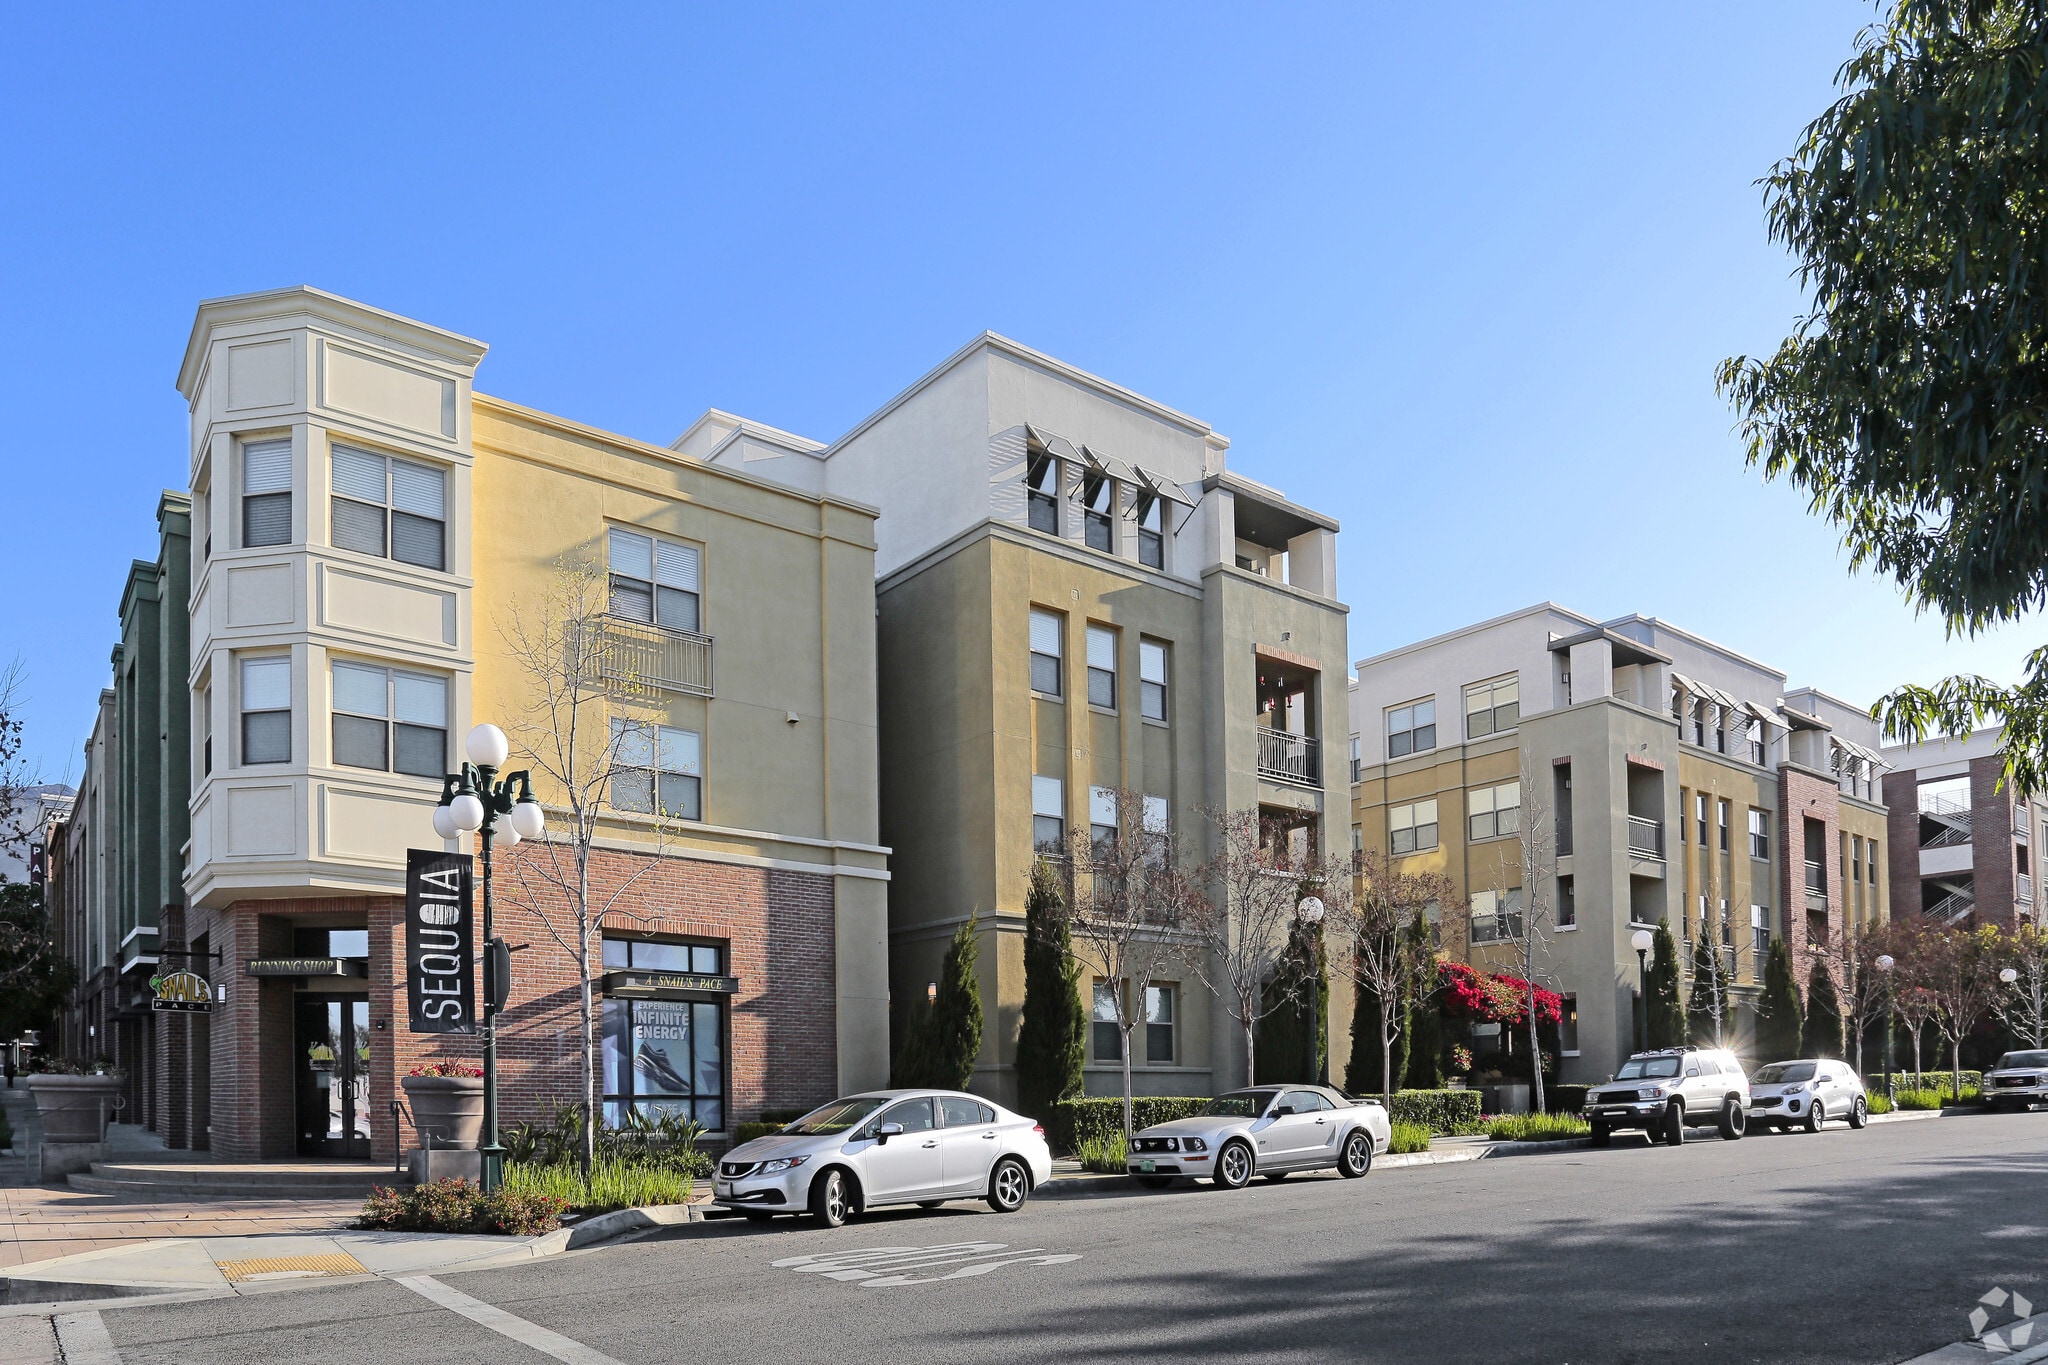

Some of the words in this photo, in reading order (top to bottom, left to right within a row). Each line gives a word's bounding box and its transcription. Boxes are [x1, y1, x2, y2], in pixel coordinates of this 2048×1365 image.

[419, 868, 462, 1020] SEQUOIA
[250, 960, 301, 973] RUNNING
[303, 960, 334, 973] SHOP
[645, 976, 653, 986] A
[657, 976, 694, 988] SNAIL'S
[699, 978, 723, 990] PACE
[155, 1001, 209, 1011] PACE
[638, 1001, 684, 1012] EXPERIENCE
[633, 1010, 689, 1026] INFINITE
[635, 1025, 687, 1040] ENERGY
